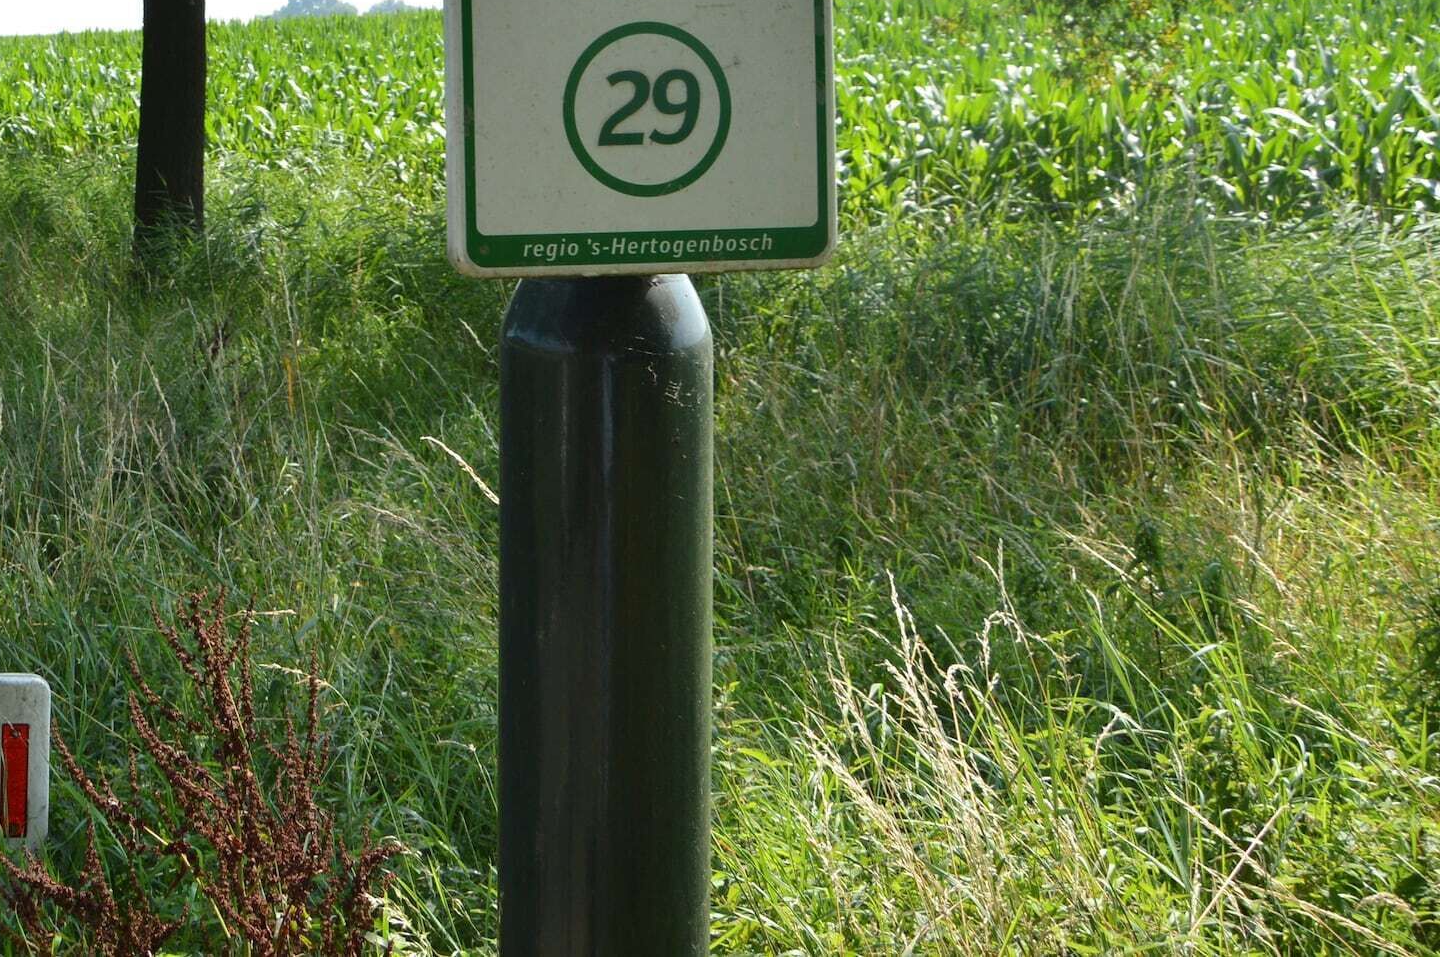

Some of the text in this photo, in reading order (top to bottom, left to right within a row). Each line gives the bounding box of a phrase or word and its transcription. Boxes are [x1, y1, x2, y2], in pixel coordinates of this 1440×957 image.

[597, 69, 701, 147] 29
[523, 233, 773, 261] regio 's-Hertogenbosch
